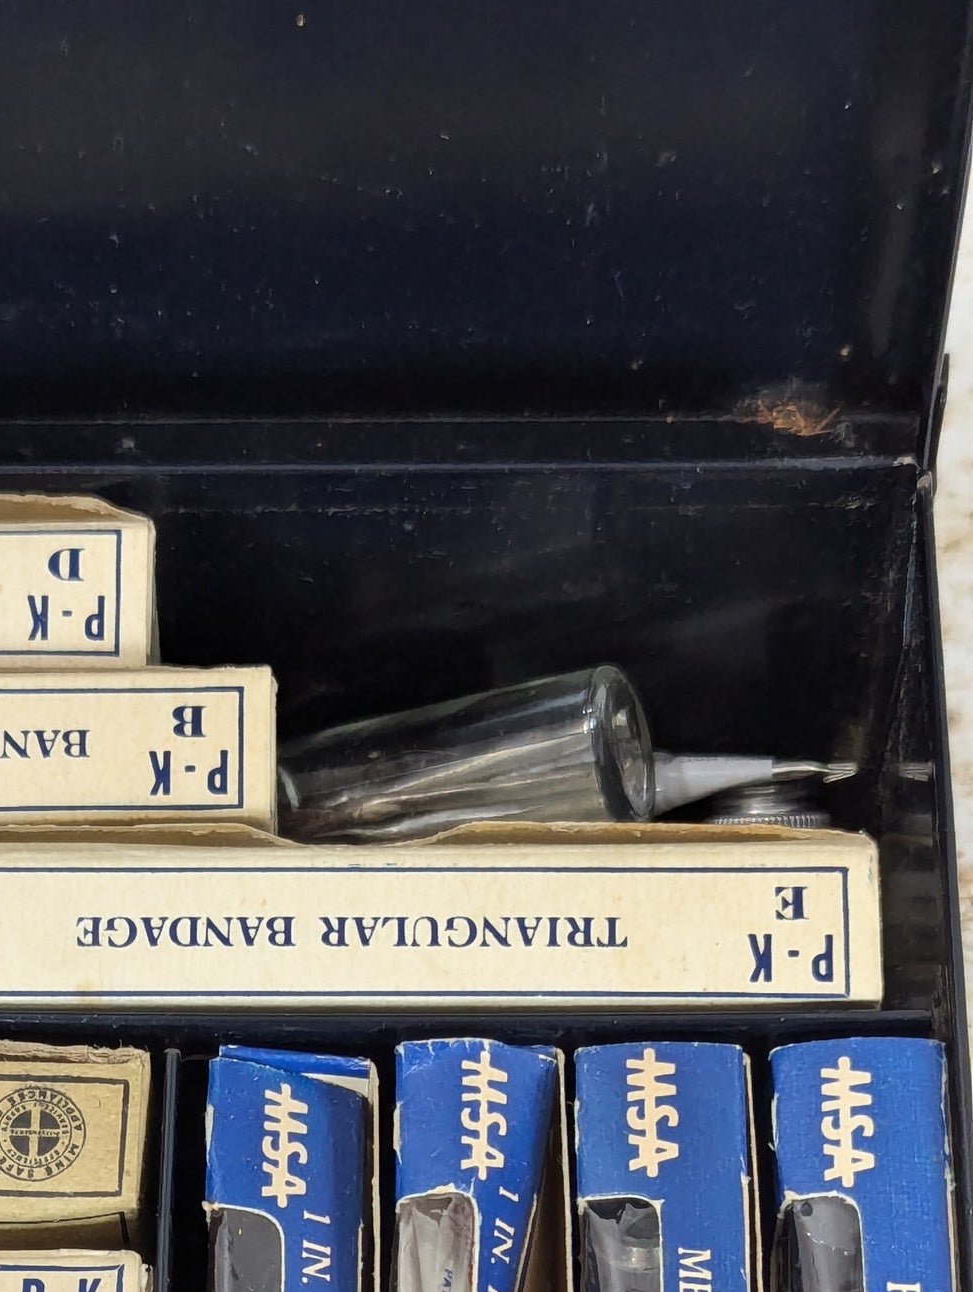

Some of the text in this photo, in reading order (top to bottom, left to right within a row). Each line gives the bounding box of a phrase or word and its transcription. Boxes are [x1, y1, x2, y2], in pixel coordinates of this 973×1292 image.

[47, 547, 86, 582] D
[171, 704, 207, 738] B
[774, 884, 808, 920] E
[76, 914, 628, 949] TRIANGULAR BANDAGE
[461, 1051, 509, 1180] MSA
[626, 1047, 679, 1178] MSA
[820, 1056, 875, 1188] MSA
[261, 1082, 309, 1208] MSA
[301, 1241, 332, 1285] IN.
[489, 1218, 516, 1265] IN.
